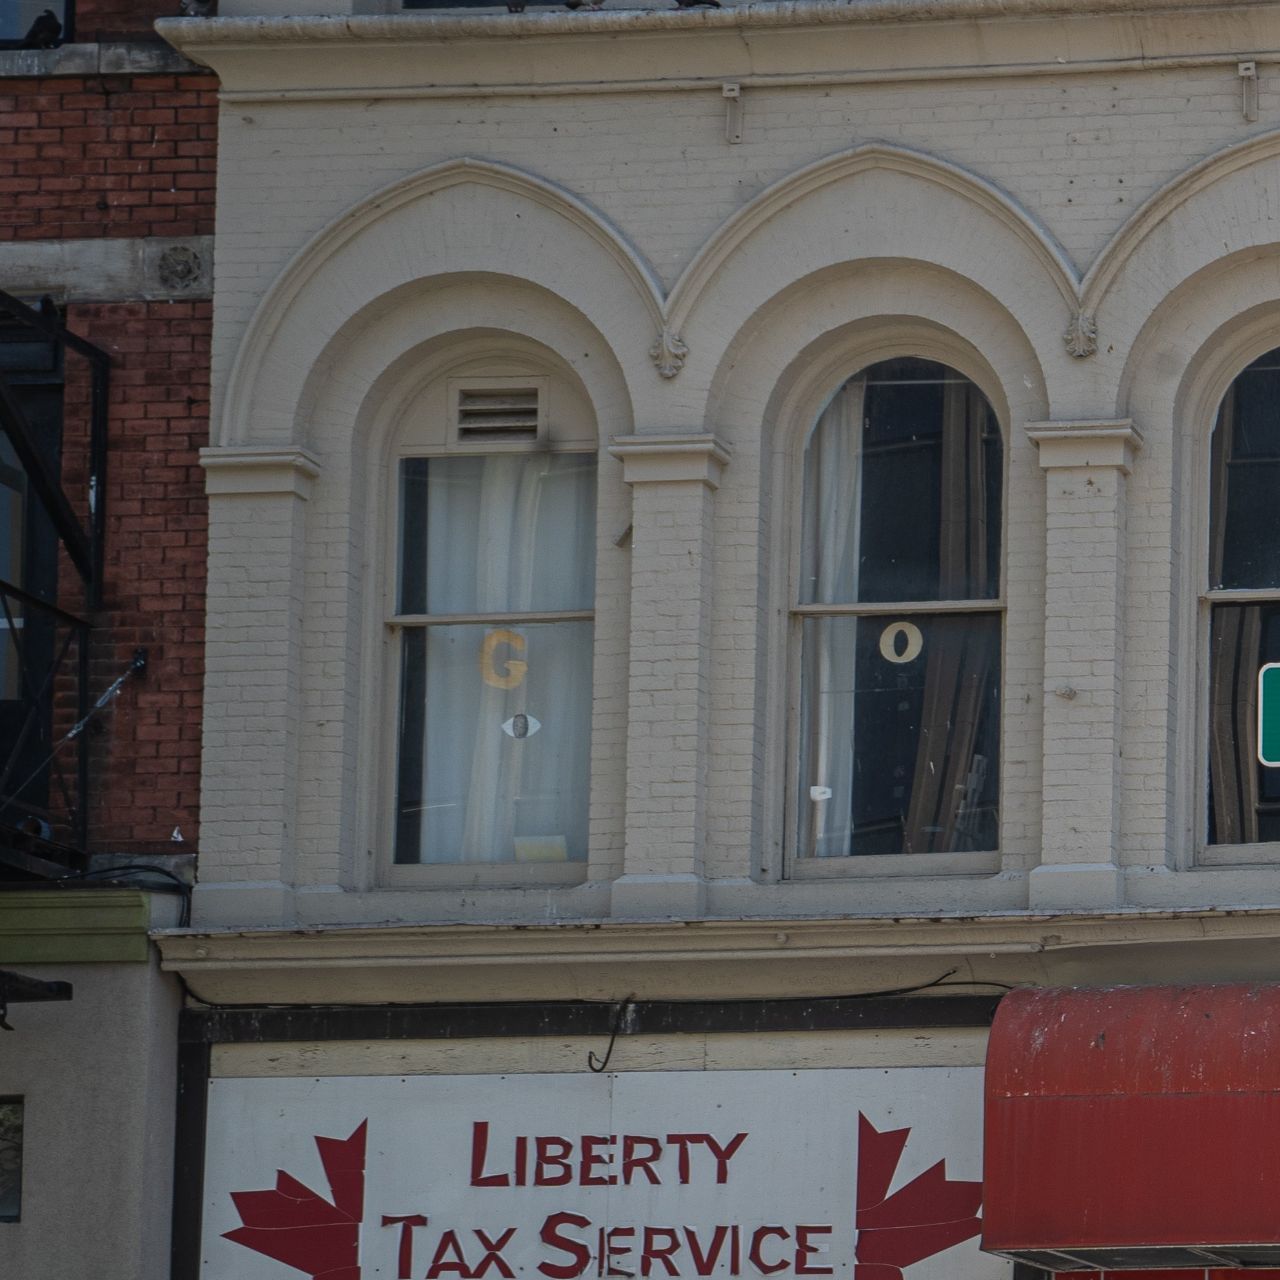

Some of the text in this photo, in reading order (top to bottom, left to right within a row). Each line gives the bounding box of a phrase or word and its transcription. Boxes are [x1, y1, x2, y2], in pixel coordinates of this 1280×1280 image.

[470, 1120, 750, 1188] LIBERTY
[381, 1210, 835, 1280] TAX SERVICE
